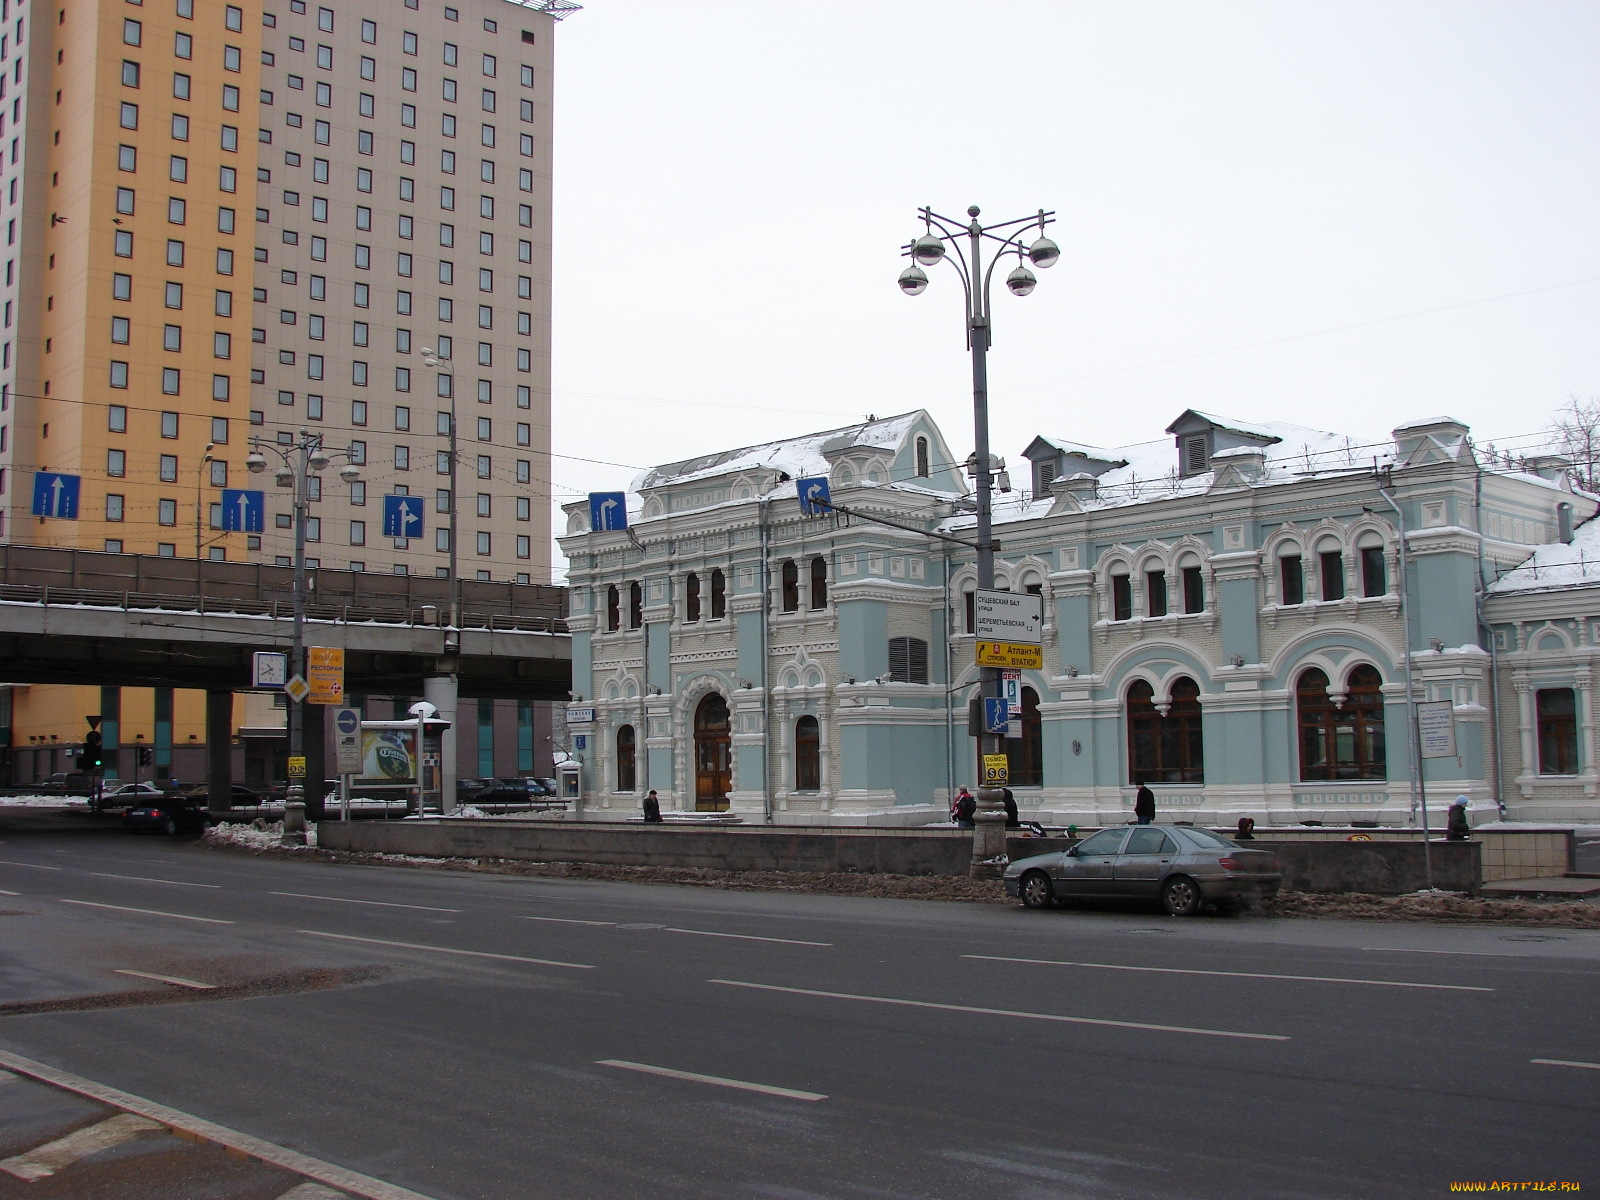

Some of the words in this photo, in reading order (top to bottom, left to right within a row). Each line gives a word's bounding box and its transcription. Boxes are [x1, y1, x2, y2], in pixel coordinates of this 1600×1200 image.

[978, 596, 1008, 606] СУЩЕВСКИЙ
[978, 617, 1025, 627] ШЕРЕМЕТЬЕВСКАЯ
[1007, 646, 1041, 656] Атлант-М
[1011, 657, 1037, 667] ВУАТЮР
[1003, 673, 1020, 681] ДЕНТ
